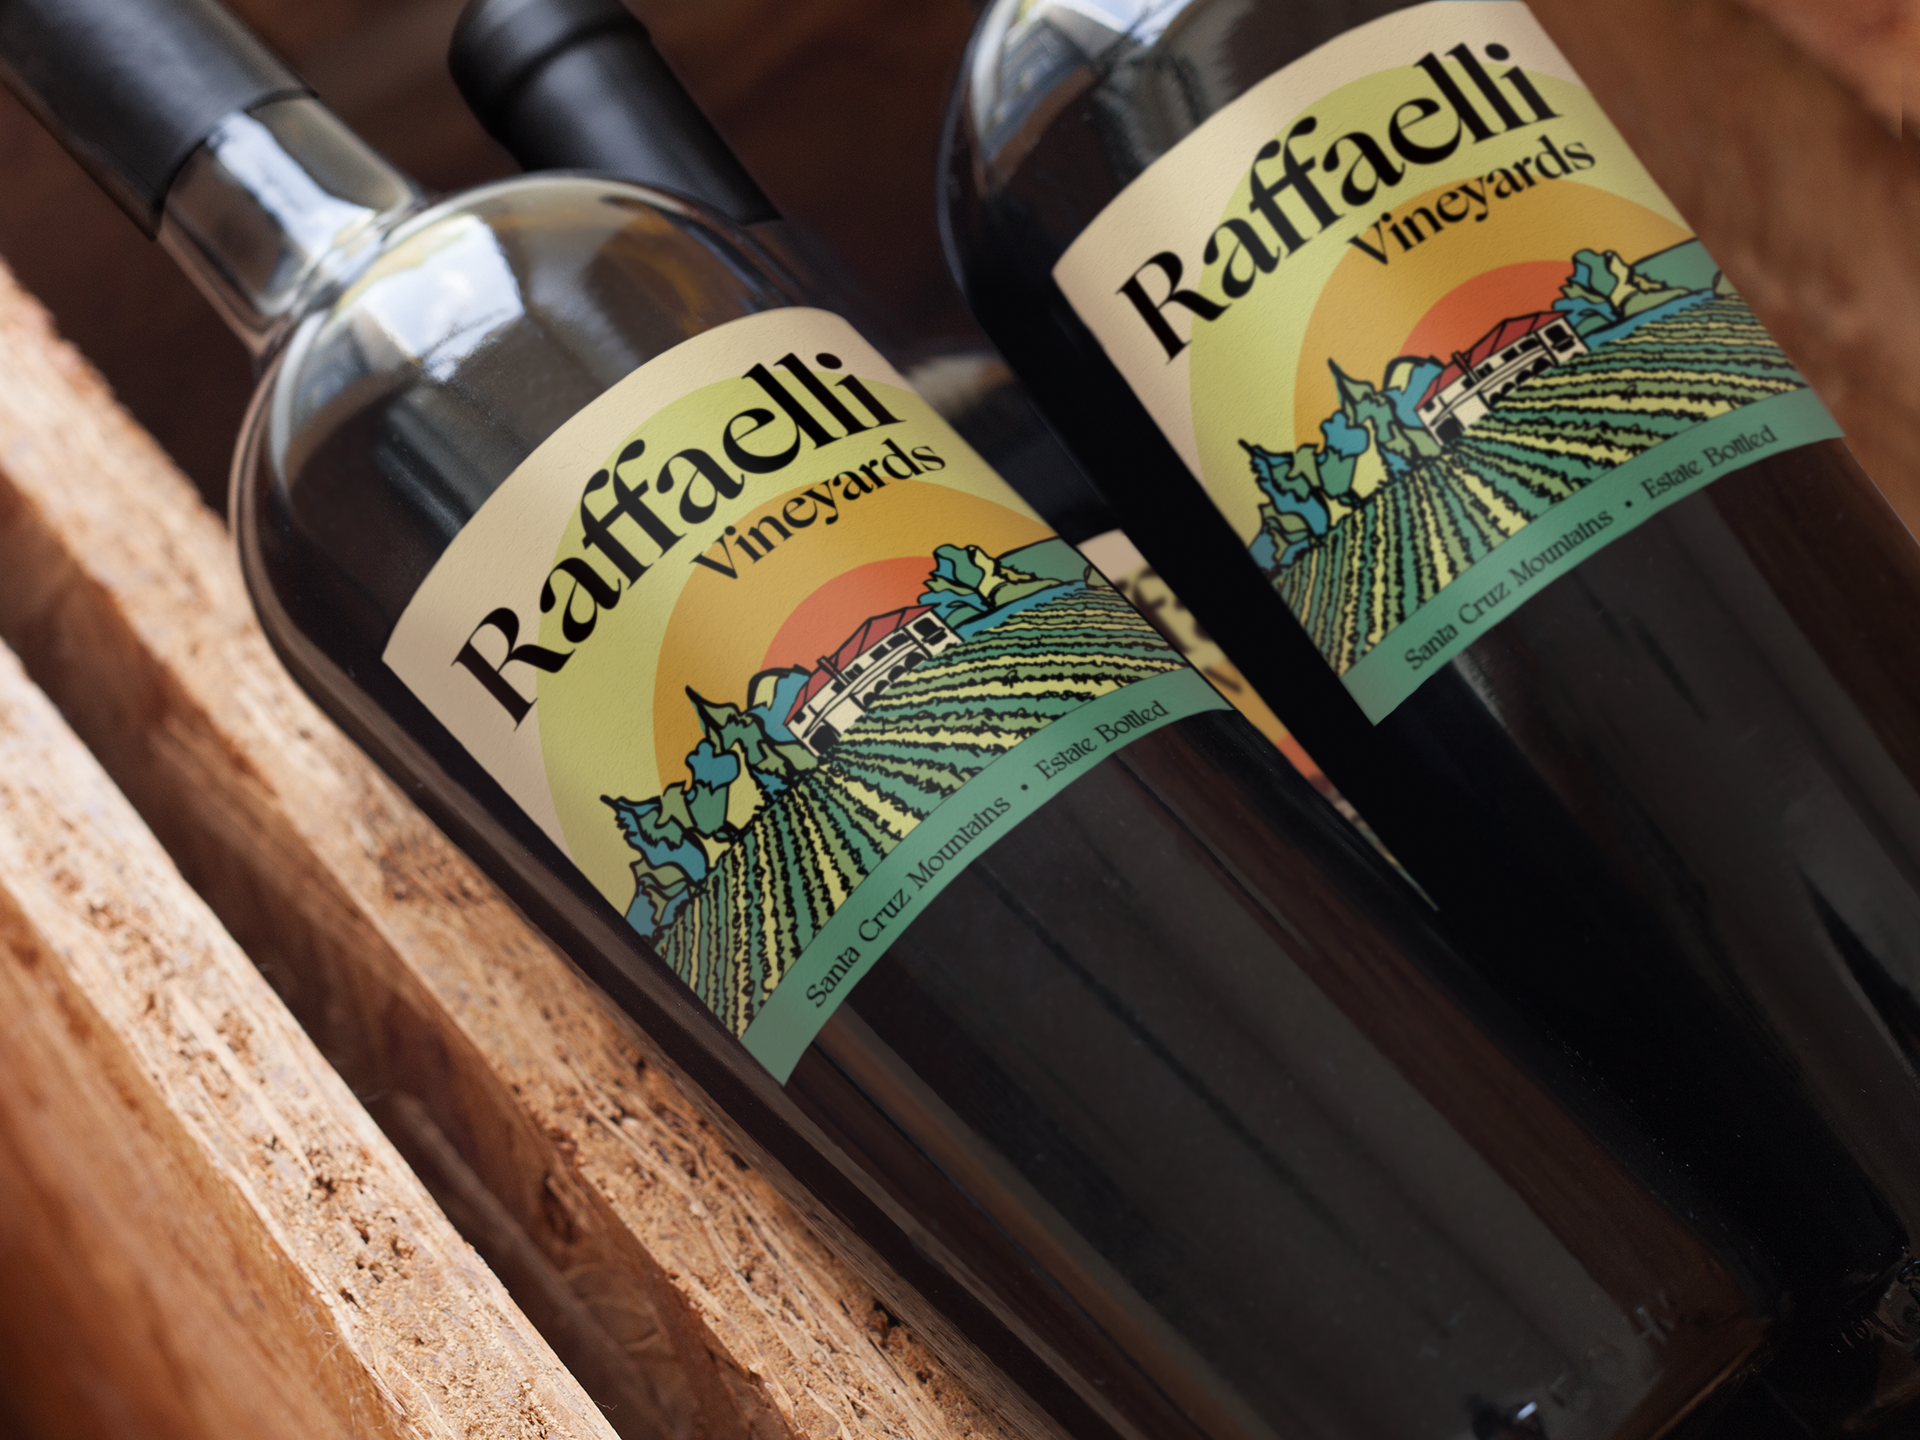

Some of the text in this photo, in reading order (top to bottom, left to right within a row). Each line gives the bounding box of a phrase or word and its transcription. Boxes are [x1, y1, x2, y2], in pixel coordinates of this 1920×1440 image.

[1117, 43, 1563, 362] Raffaelli
[1346, 135, 1595, 266] Vineyards
[451, 352, 907, 732] Raffaelli
[690, 438, 946, 580] Vineyards
[1404, 425, 1777, 670] Santa Cruz Mountains Estate Bottled
[805, 700, 1170, 1007] Santa Cruz Mountains Estate Bottled
